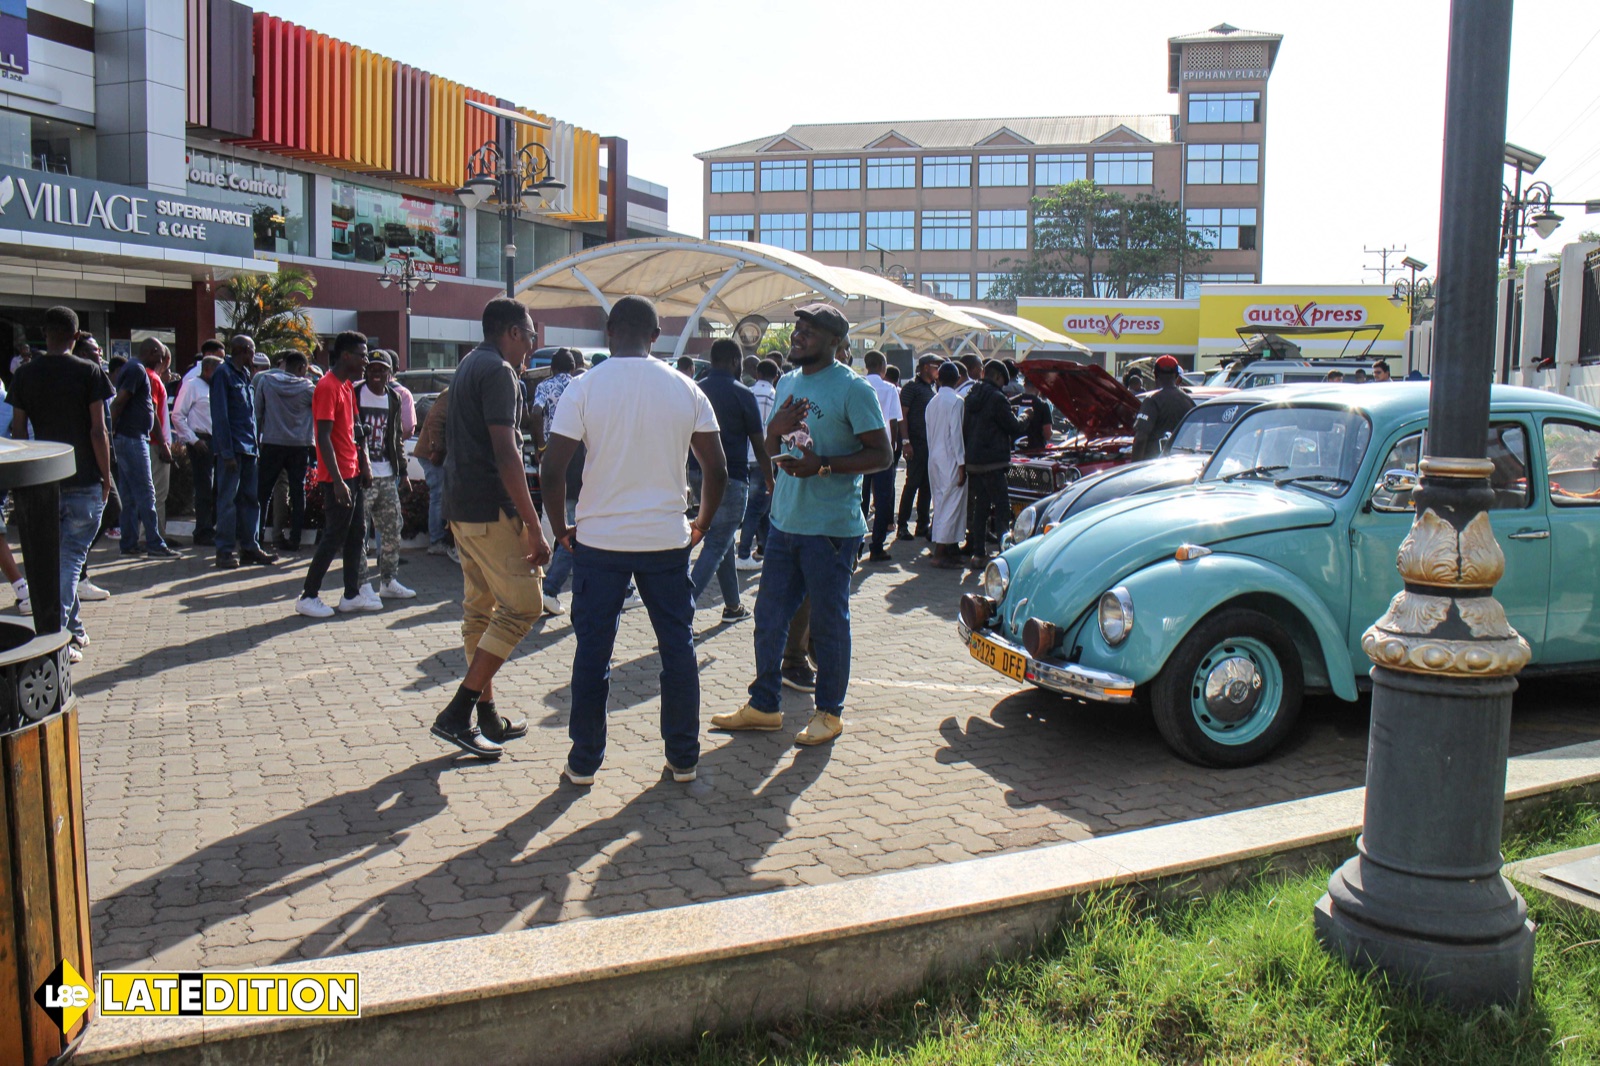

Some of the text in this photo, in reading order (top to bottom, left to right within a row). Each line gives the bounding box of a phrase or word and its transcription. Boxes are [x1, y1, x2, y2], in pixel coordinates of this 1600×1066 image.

[1183, 69, 1269, 80] EPIPHANY PLAZA
[187, 168, 288, 198] ome Comfort
[17, 177, 150, 235] VILLAGE
[156, 200, 252, 228] SUPERMARKET
[158, 222, 207, 241] & CAFÉ
[1067, 313, 1161, 340] autoXpress
[1248, 301, 1363, 326] autoXpress
[1002, 652, 1023, 680] DFE
